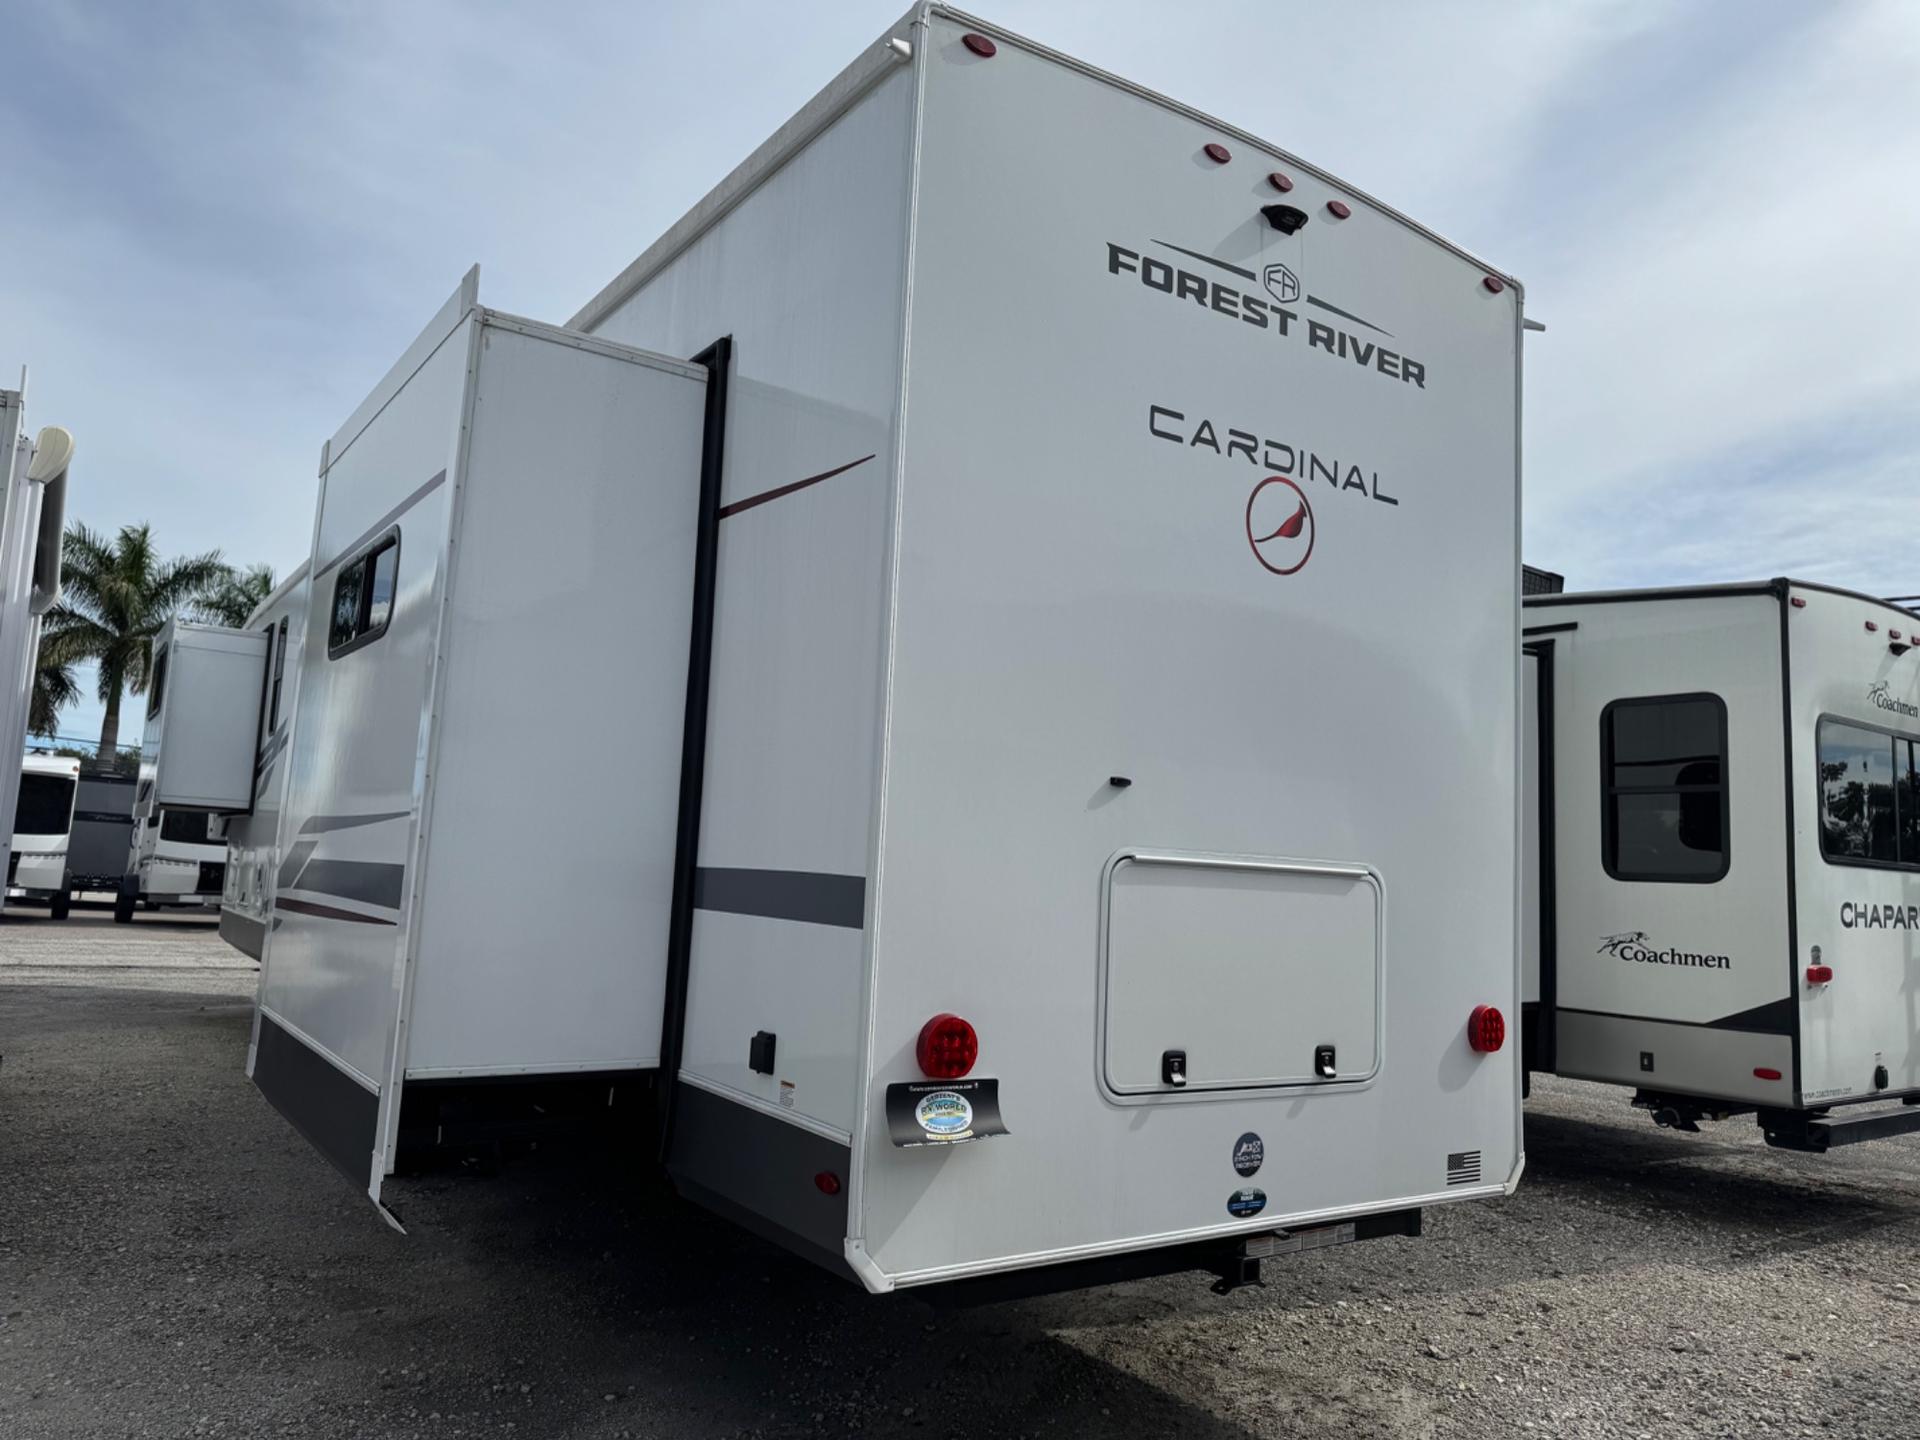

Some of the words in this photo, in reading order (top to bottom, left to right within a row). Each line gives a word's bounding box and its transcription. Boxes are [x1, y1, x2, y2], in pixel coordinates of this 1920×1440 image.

[1106, 241, 1298, 337] FOREST
[1306, 318, 1426, 389] RIVER
[1148, 404, 1399, 506] CARDINAL
[1876, 692, 1919, 718] Coachmen
[1840, 901, 1920, 930] CHAPAR
[1619, 945, 1731, 969] Coachmen
